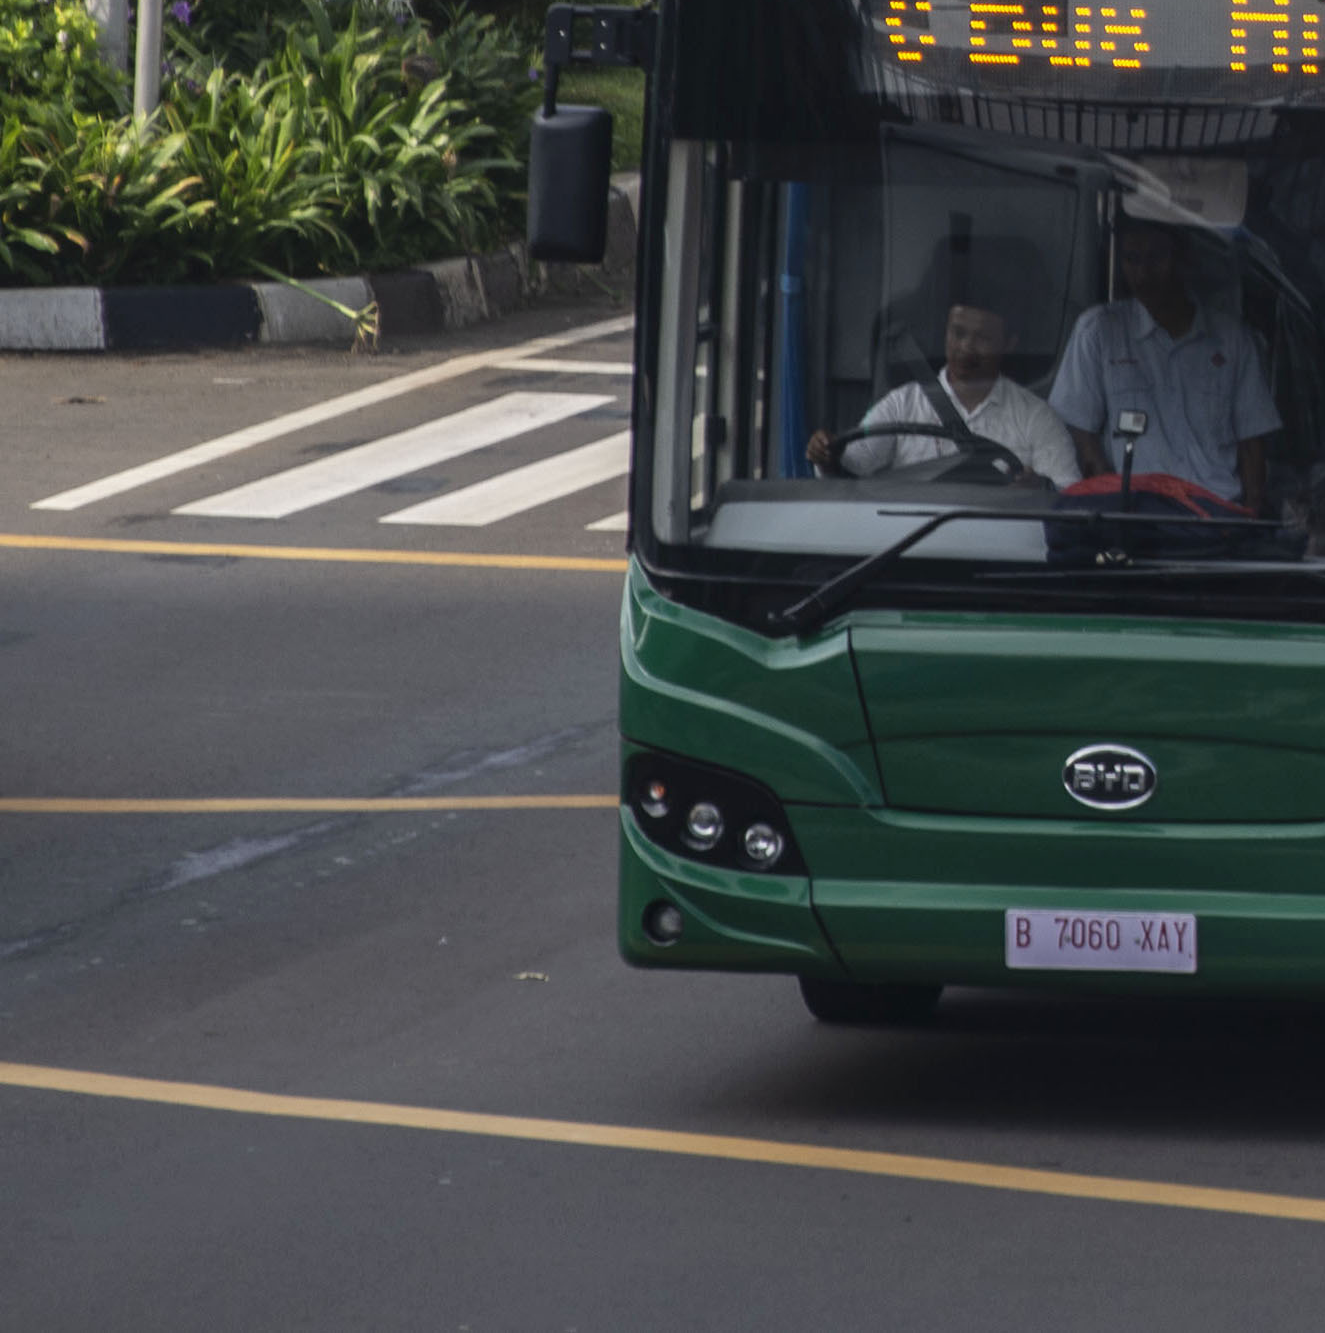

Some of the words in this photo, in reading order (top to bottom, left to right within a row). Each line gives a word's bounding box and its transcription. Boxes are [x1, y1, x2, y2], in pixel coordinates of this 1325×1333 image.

[1073, 763, 1146, 792] BYD
[1016, 917, 1032, 948] B
[1054, 918, 1121, 951] 7060
[1140, 920, 1188, 952] XAY
